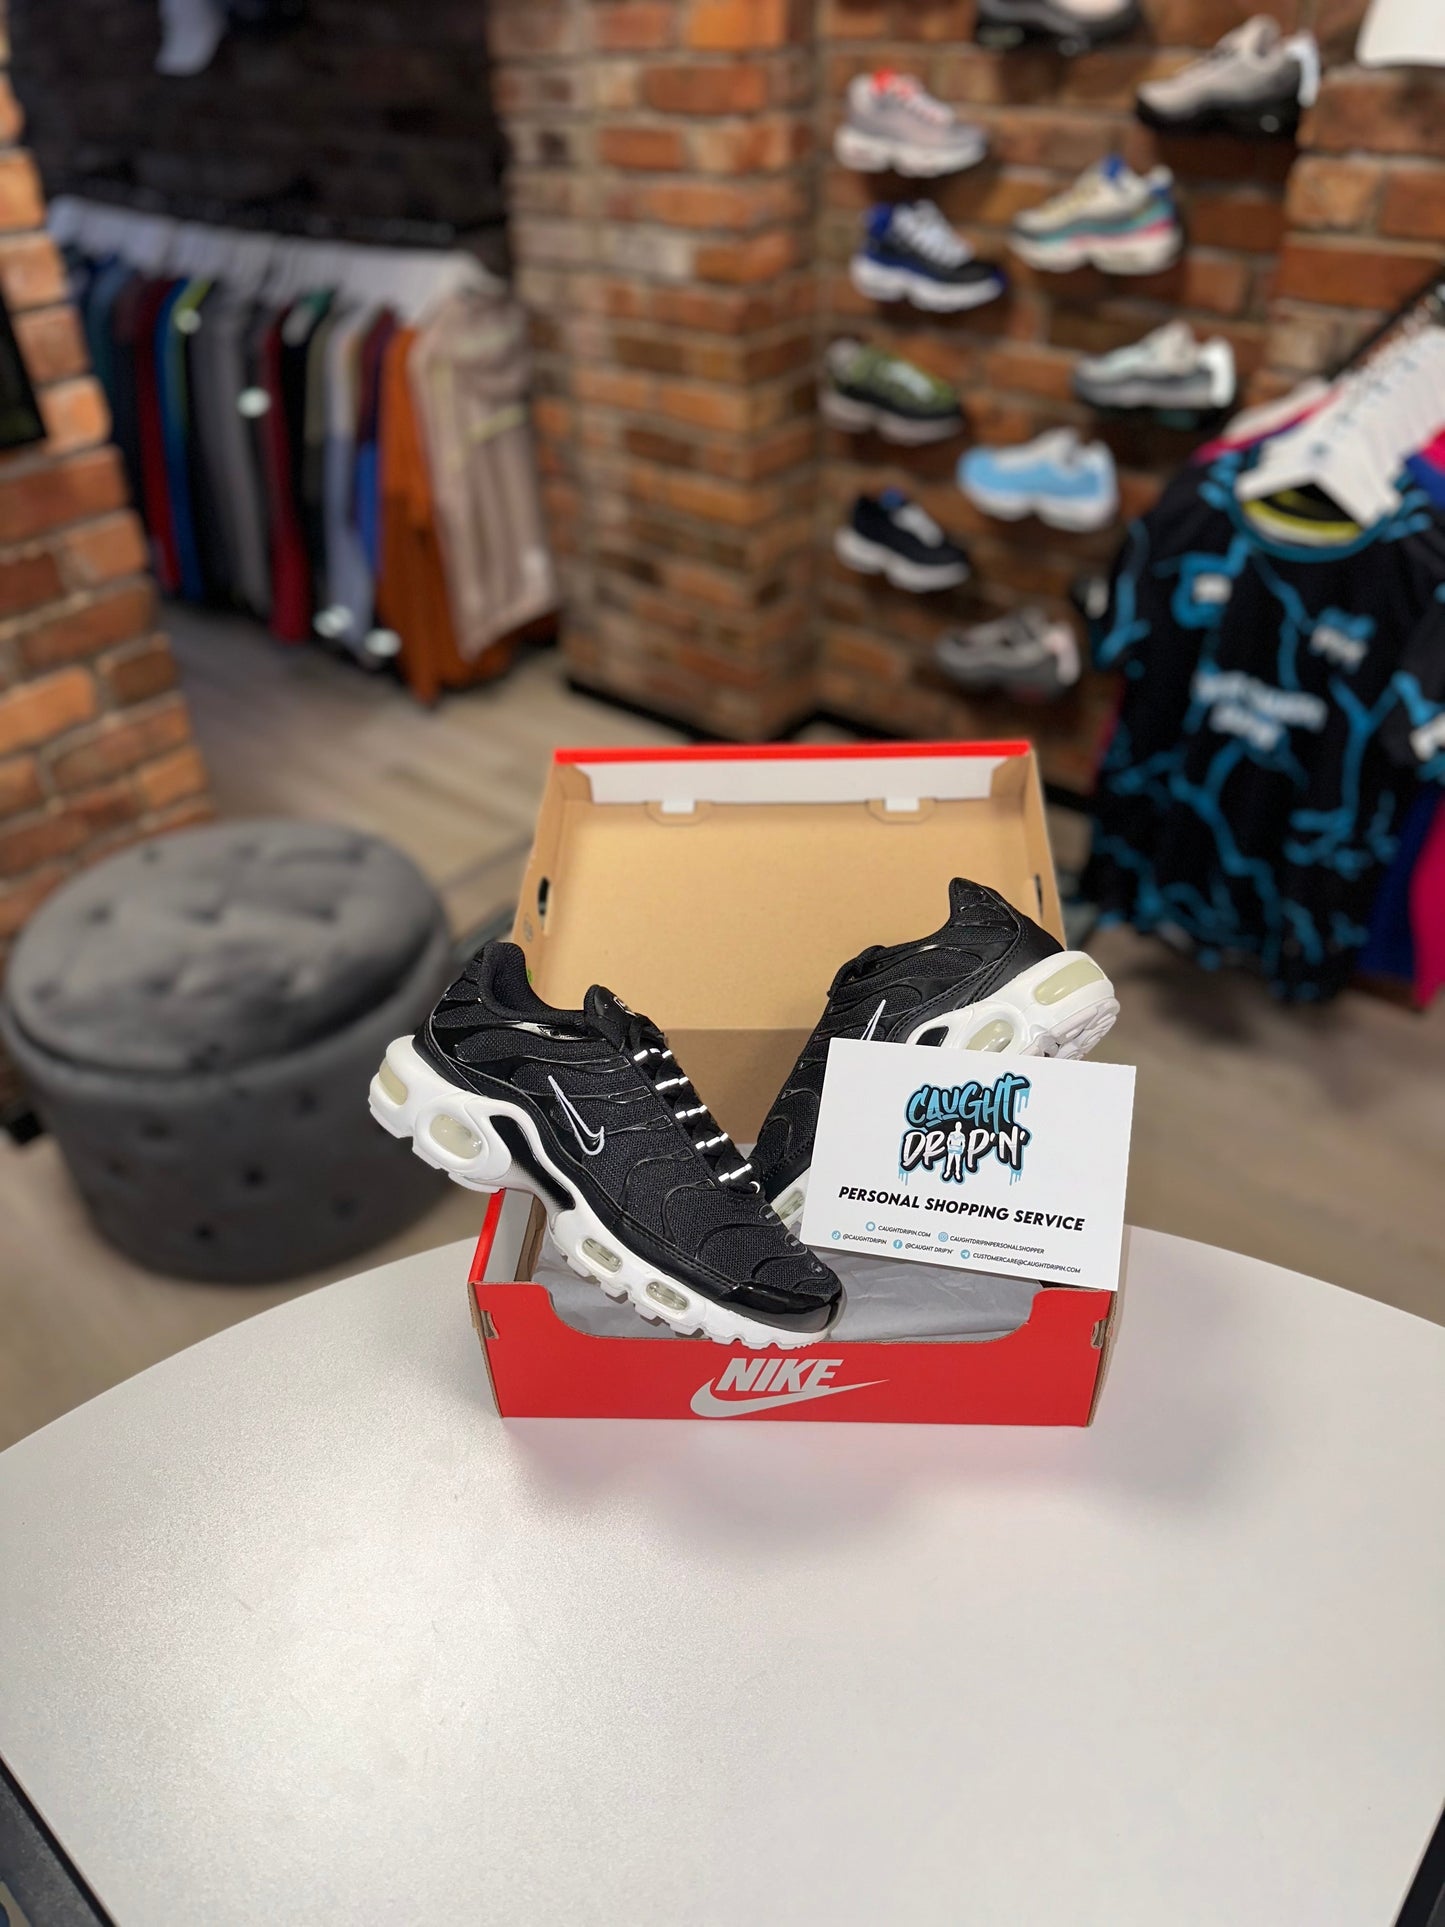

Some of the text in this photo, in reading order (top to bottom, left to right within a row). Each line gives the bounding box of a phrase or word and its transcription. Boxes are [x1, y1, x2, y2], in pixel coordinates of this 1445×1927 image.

[906, 1073, 1029, 1134] CAUGHT
[838, 1186, 1086, 1232] PERSONAL SHOPPING SERVICE
[877, 1225, 932, 1238] CAUGHTDRIPIN.COM
[972, 1252, 1081, 1274] CUSTOMERCARE@CAUGHTDRIPIN.COM
[715, 1357, 844, 1393] NIKE
